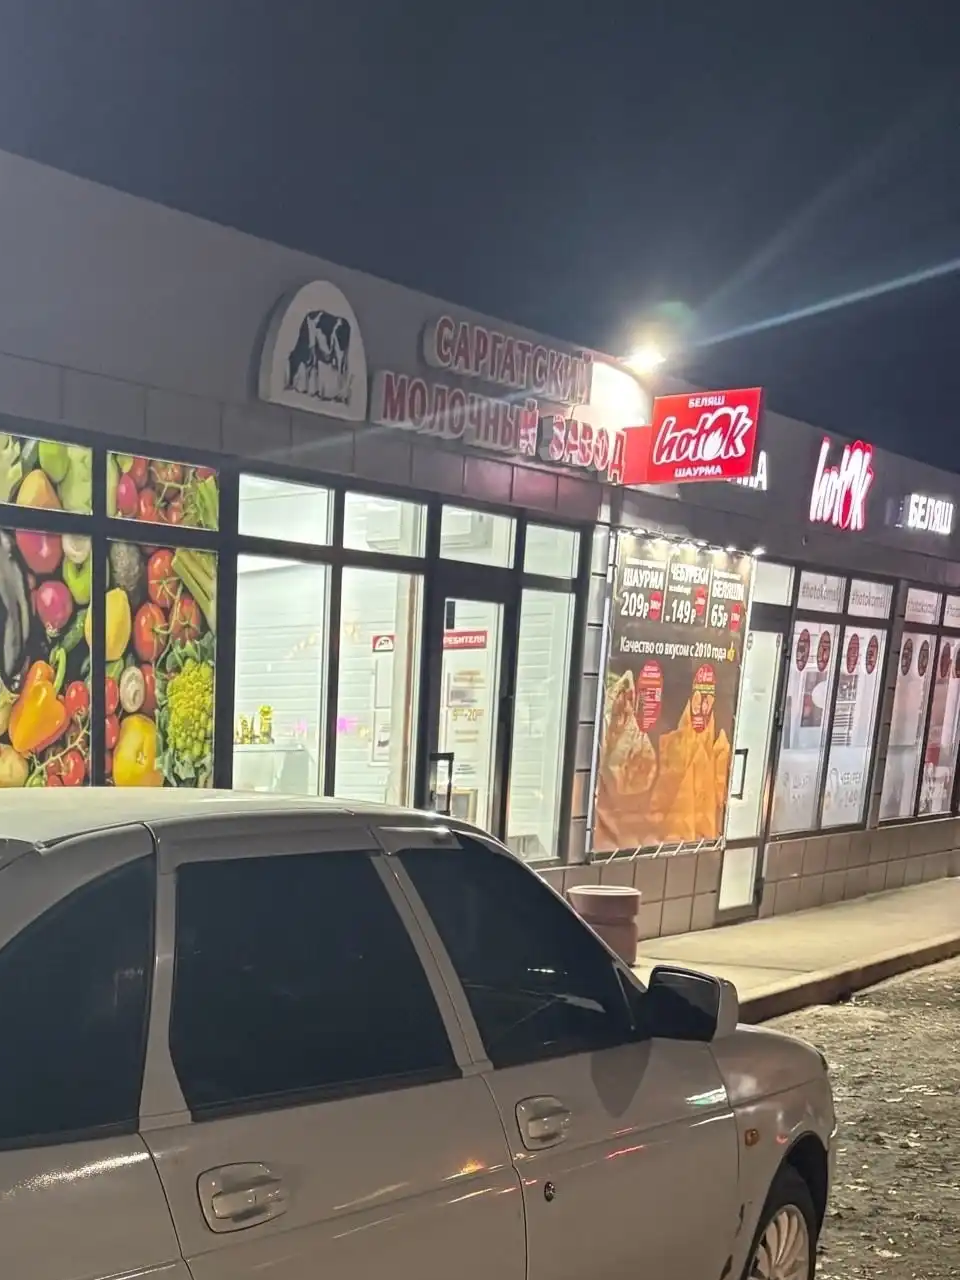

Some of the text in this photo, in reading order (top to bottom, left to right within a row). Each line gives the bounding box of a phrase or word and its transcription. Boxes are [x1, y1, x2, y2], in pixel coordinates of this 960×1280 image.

[436, 315, 594, 404] САРГАТСКИЙ
[382, 371, 538, 456] МОЛОЧНЫЙ
[688, 395, 726, 409] БЕЛЯШ
[548, 414, 628, 485] ЗАВОД
[674, 464, 722, 478] ШАУРМА
[907, 493, 954, 535] БЕЛЯШ
[623, 568, 664, 590] ШАУРМА
[620, 636, 654, 654] Качество
[655, 643, 664, 655] со
[664, 643, 689, 660] вкусом
[694, 642, 711, 658] 2010
[712, 646, 727, 662] года
